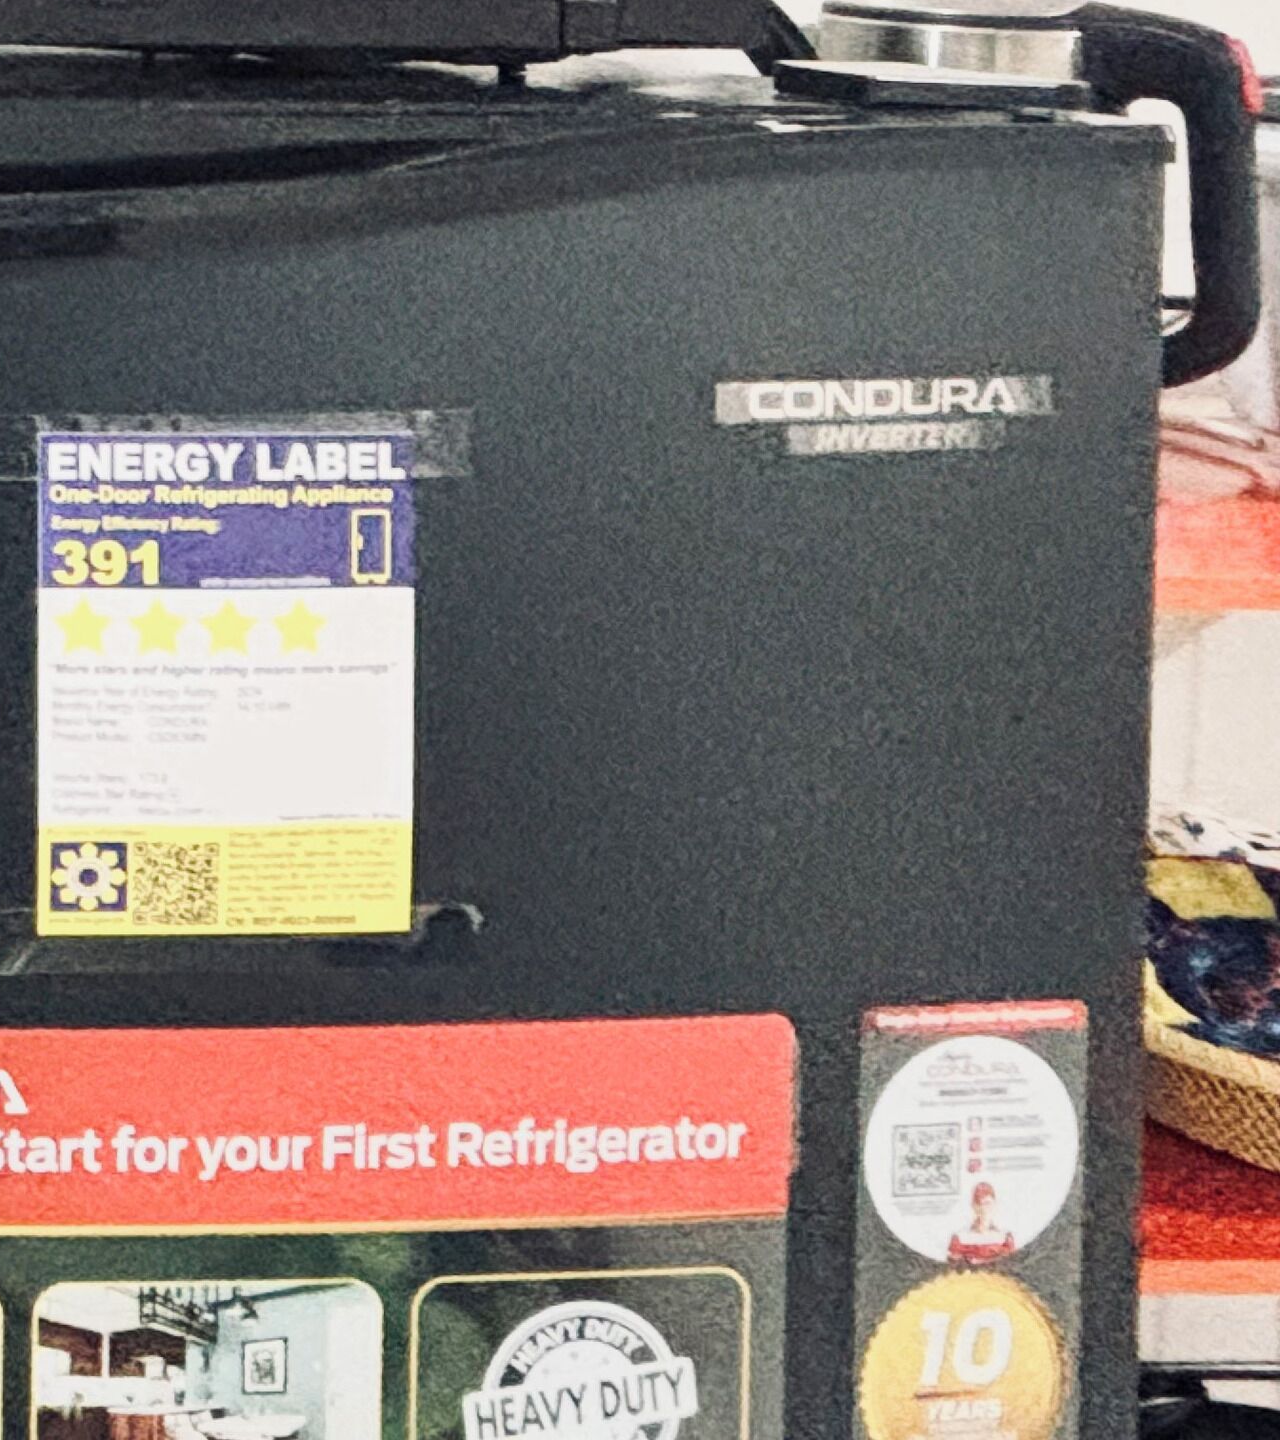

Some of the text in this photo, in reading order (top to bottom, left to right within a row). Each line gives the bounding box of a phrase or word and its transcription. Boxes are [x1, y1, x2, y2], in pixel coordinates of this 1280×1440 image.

[748, 376, 1018, 421] CONDURA
[47, 441, 407, 482] ENERGY LABEL
[49, 484, 394, 508] One-Door Refrigerating Appliance
[50, 539, 160, 586] 391
[111, 1124, 186, 1173] for
[197, 1133, 311, 1181] your
[322, 1122, 438, 1171] First
[447, 1115, 747, 1174] Refrigerator
[507, 1317, 646, 1375] HEAVY DUTY
[919, 1307, 1013, 1387] 10
[475, 1366, 684, 1440] HEAVY DUTY
